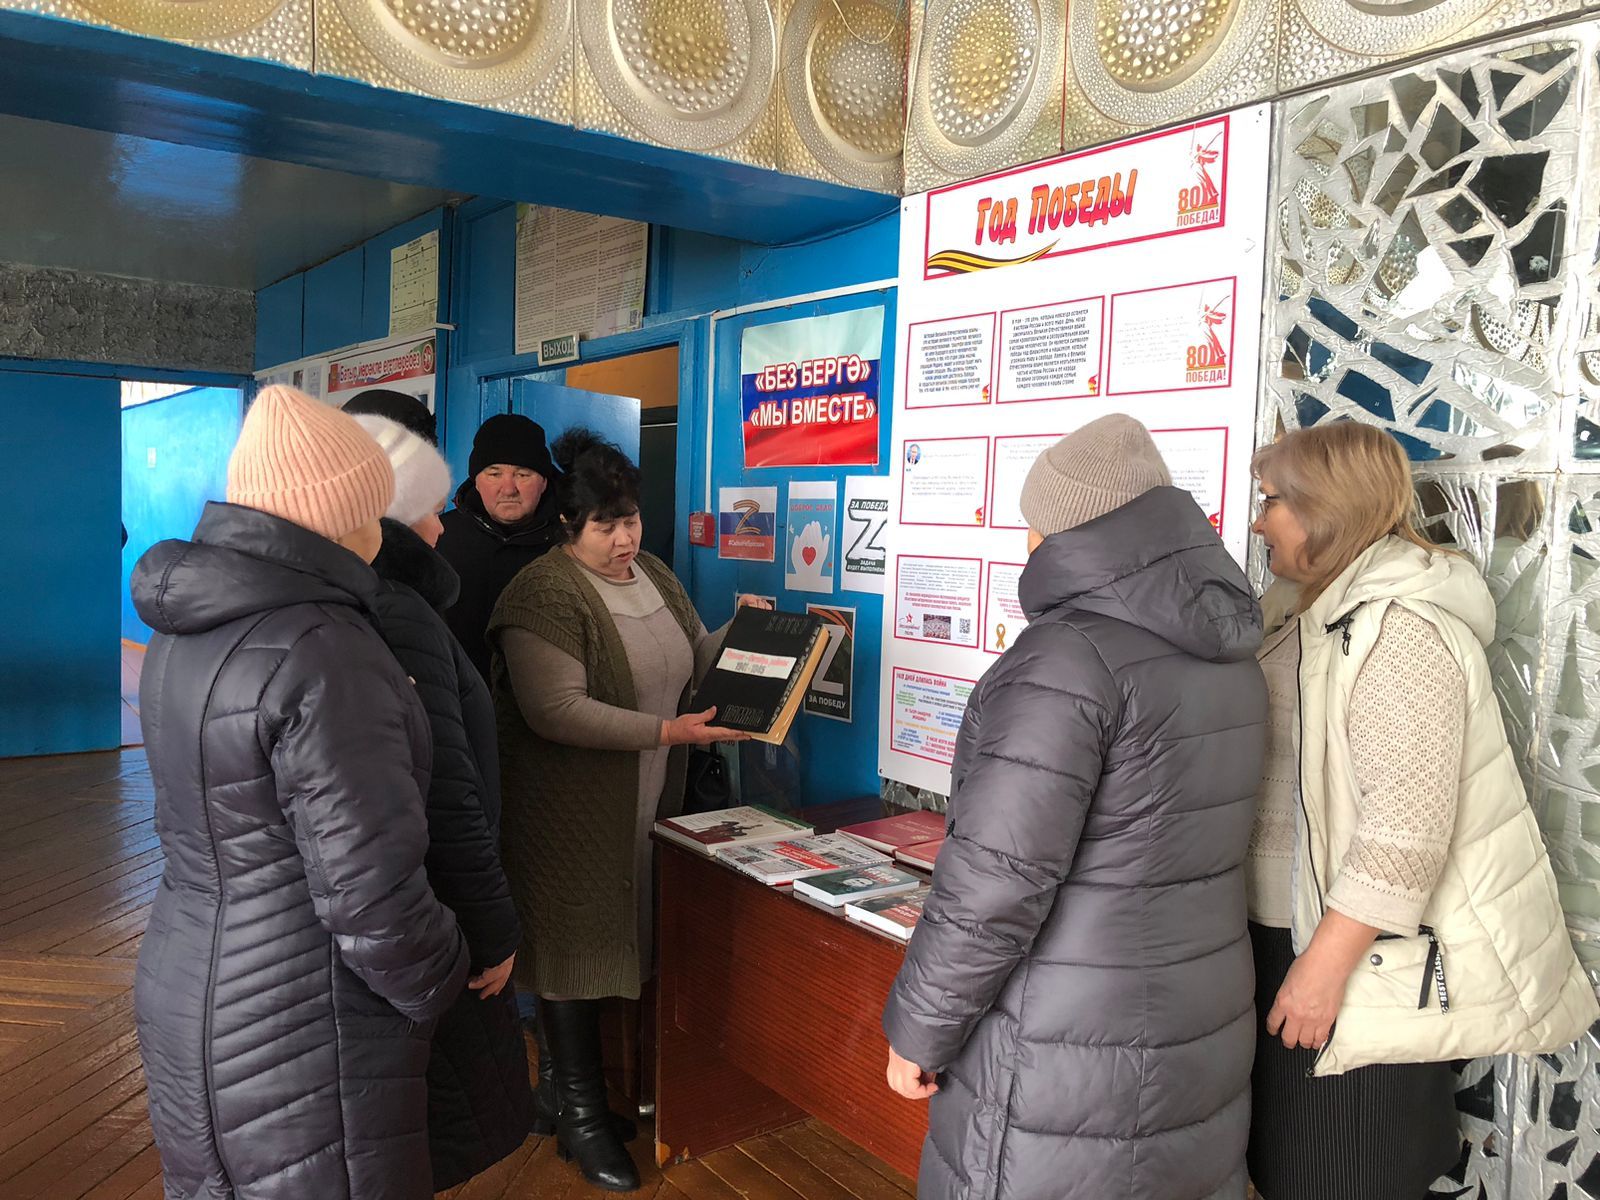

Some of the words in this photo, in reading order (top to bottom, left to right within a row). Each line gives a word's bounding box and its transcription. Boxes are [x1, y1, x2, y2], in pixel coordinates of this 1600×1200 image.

[1178, 186, 1200, 211] 80
[1177, 208, 1218, 227] ПОБЕДА!
[543, 339, 573, 357] ВЫХОД
[1187, 345, 1208, 368] 80
[755, 362, 797, 391] «БЕЗ
[801, 355, 871, 387] БЕРГӘ»
[1186, 369, 1226, 383] ПОБЕДА!
[751, 400, 788, 427] «МЫ
[791, 393, 876, 425] ВМЕСТЕ»
[850, 501, 860, 509] ЗА
[808, 695, 818, 704] ЗА
[818, 696, 846, 709] ПОБЕДУ
[1438, 981, 1448, 1001] BEST
